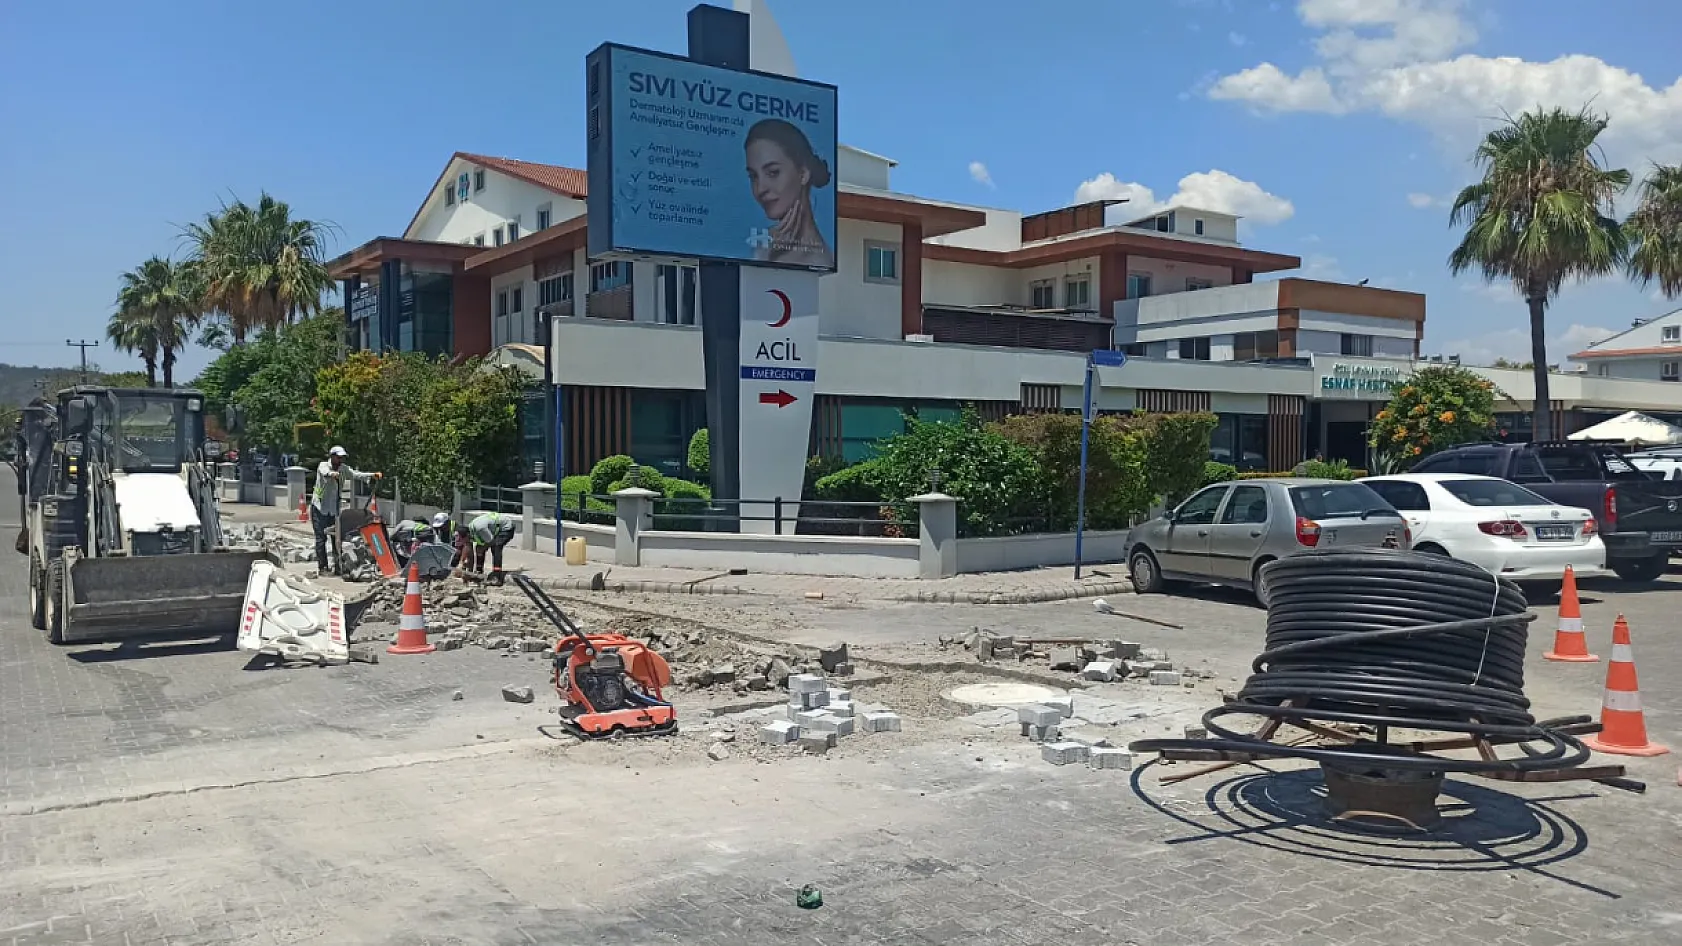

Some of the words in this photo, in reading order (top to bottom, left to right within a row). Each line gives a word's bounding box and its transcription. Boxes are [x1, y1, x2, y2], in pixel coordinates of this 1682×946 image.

[629, 72, 676, 98] SIVI
[682, 79, 732, 107] YÜZ
[737, 91, 819, 124] GERME
[629, 98, 686, 119] Dermatoloji
[686, 120, 736, 136] Gençleşme
[648, 171, 676, 184] Doğal
[669, 202, 709, 215] ovalinde
[648, 211, 704, 225] toparlanma
[755, 337, 802, 361] ACİL
[752, 368, 806, 380] EMERGENCY
[1321, 376, 1356, 390] ESNAF
